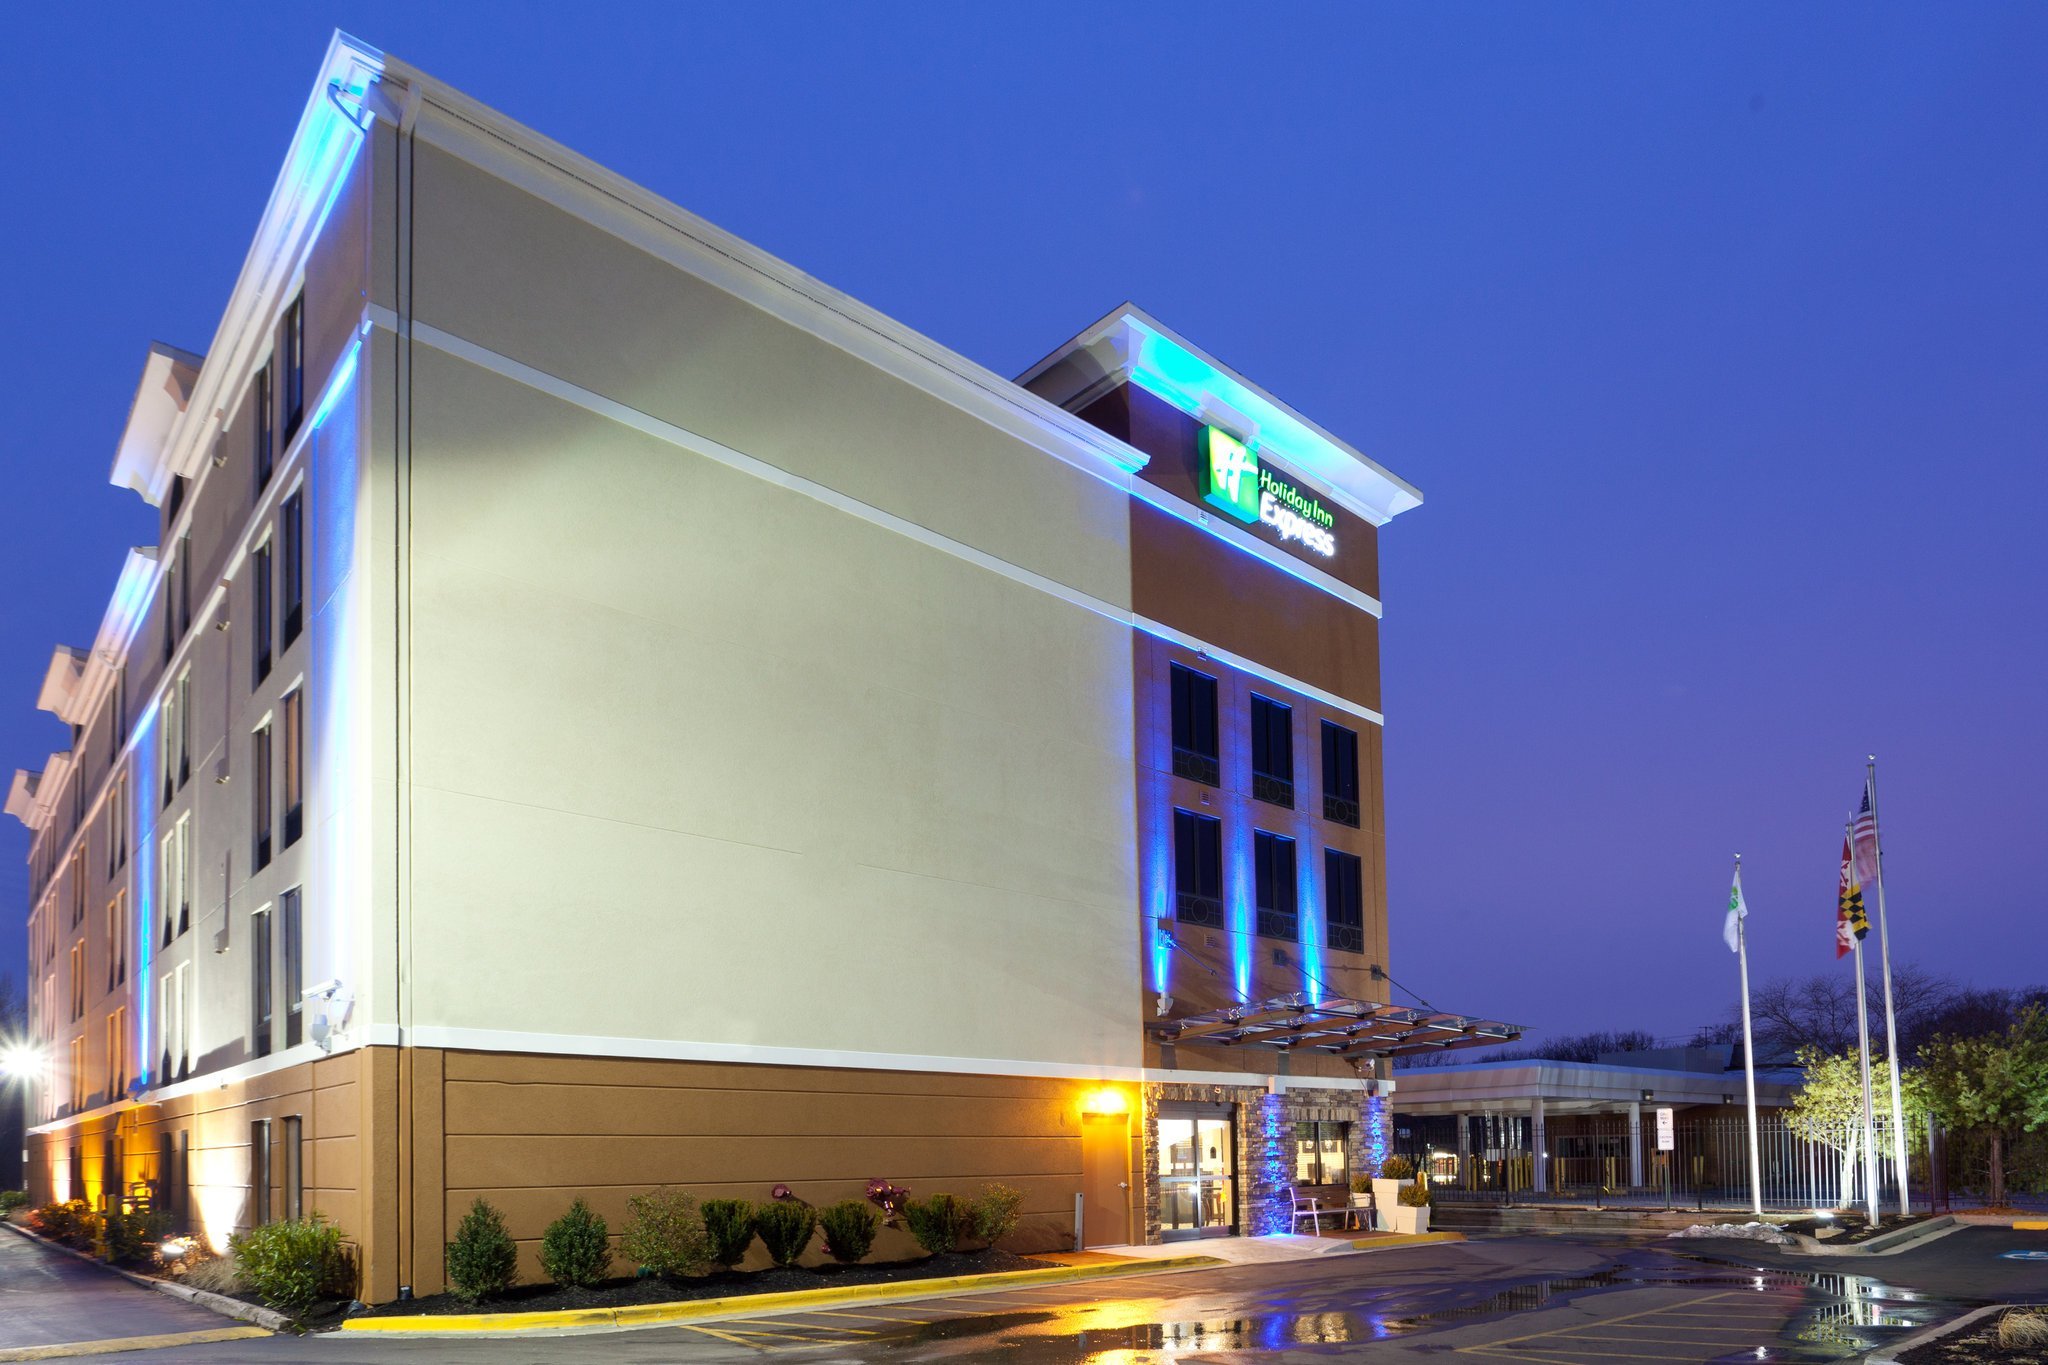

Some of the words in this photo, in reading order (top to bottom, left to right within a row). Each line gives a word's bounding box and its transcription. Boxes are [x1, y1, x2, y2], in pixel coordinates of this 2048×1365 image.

[1260, 469, 1312, 517] Holiday
[1313, 500, 1333, 527] Inn
[1260, 491, 1334, 556] Express
